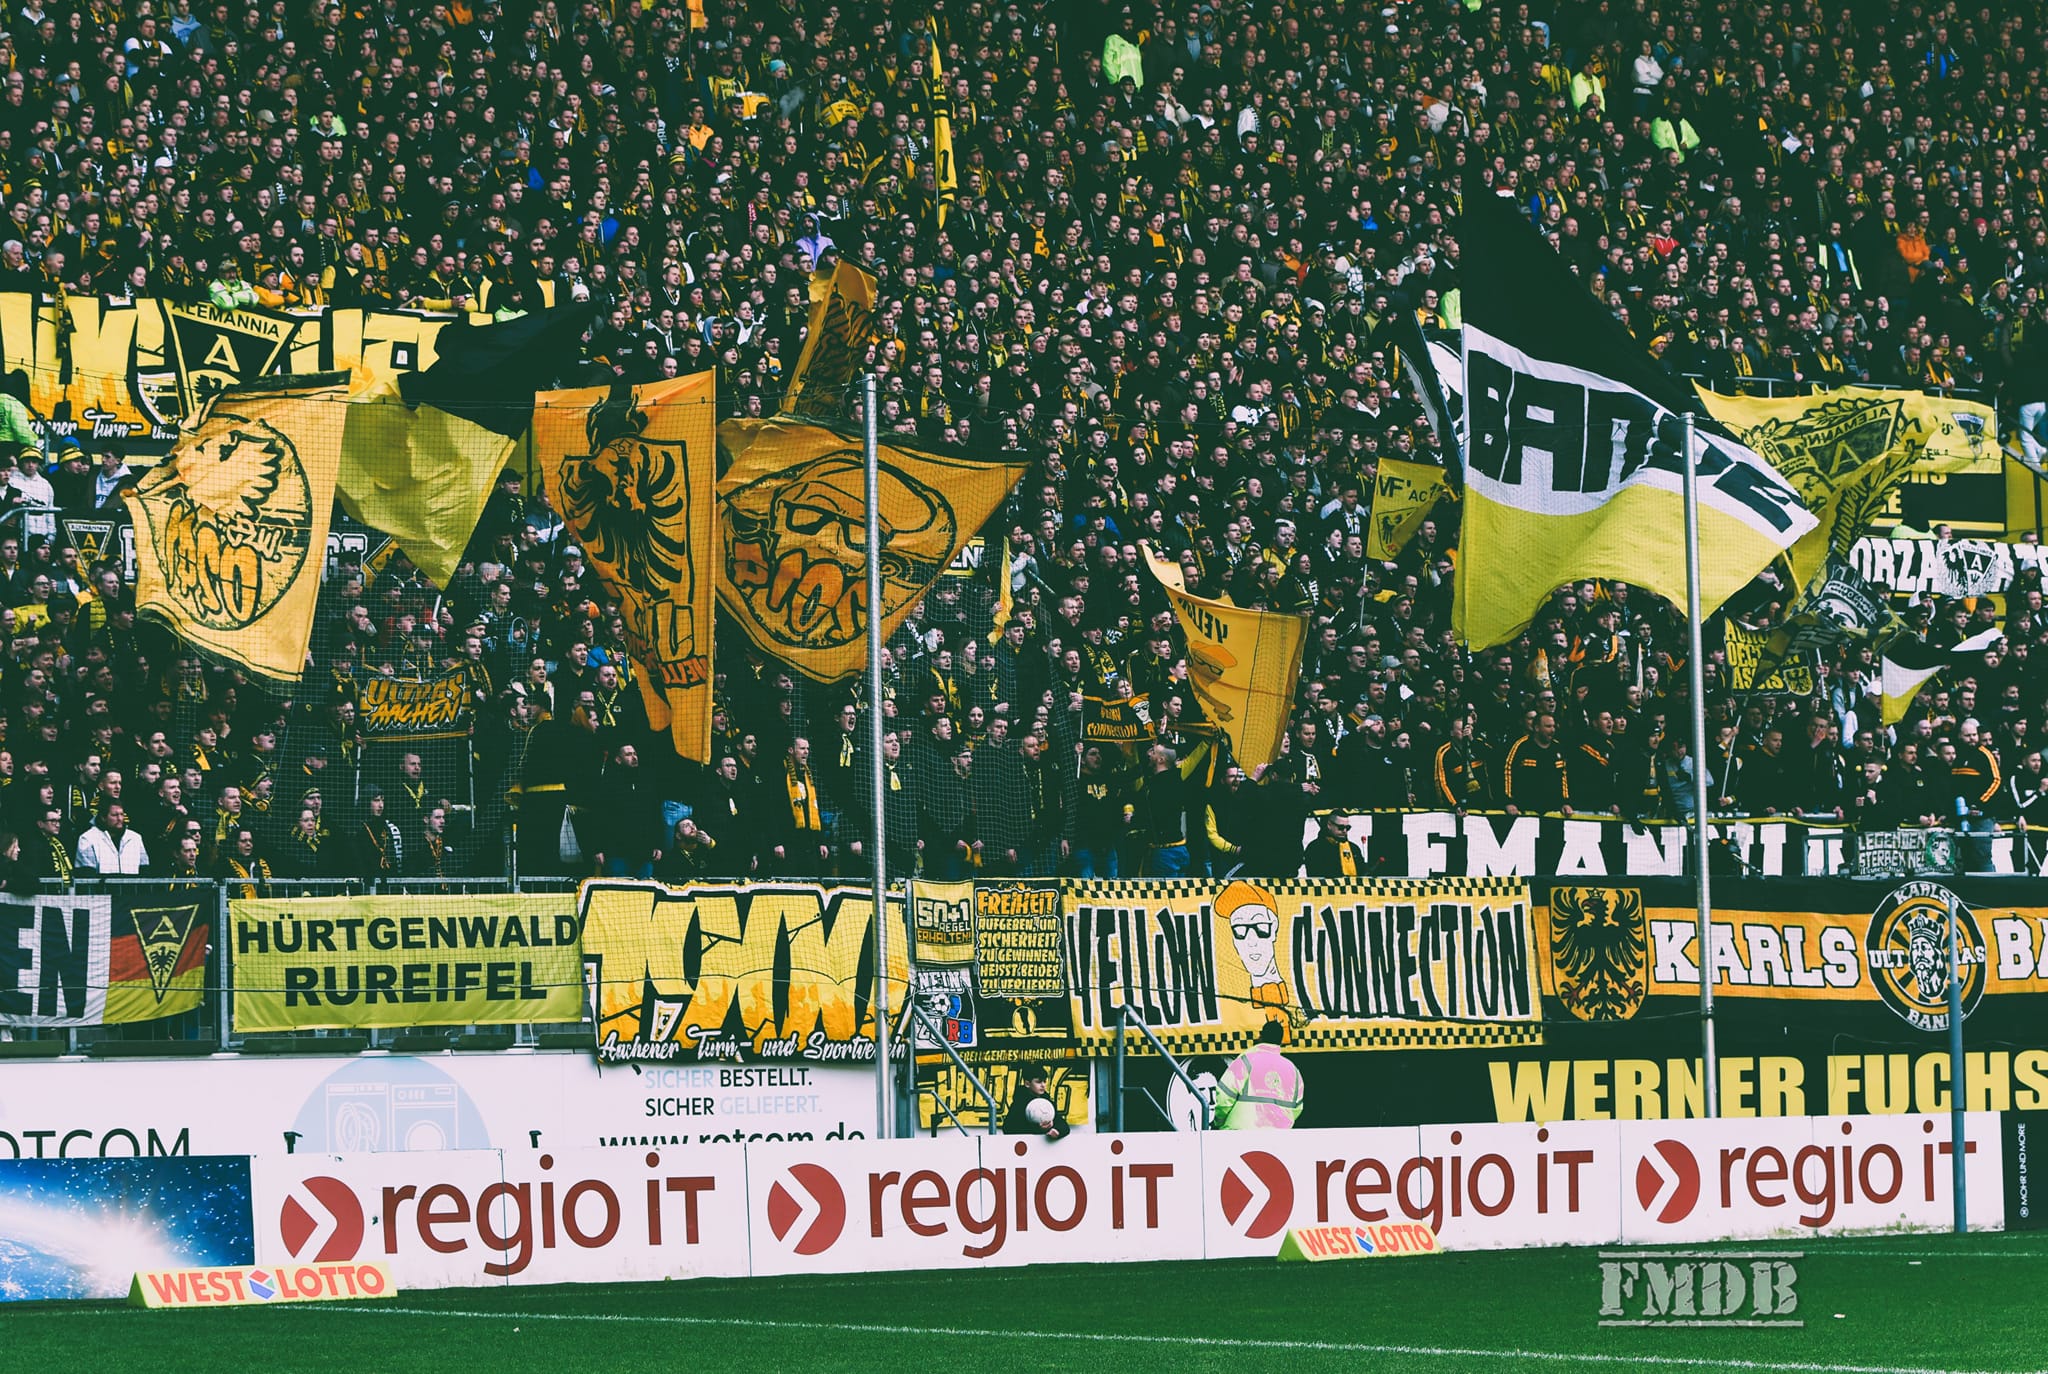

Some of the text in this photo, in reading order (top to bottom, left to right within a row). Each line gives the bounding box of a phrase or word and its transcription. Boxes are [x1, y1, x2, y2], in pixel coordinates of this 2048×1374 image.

[369, 699, 460, 726] AACHEN
[238, 914, 577, 954] HÜRTGENWALD
[979, 932, 1058, 947] SICHERHEIT
[1039, 917, 1057, 930] UM
[980, 949, 995, 962] ZU
[980, 963, 1059, 977] HEISST BEIDES
[1067, 903, 1532, 1031] YELLOW CONNECTION
[1651, 920, 1861, 989] KARLS
[285, 961, 548, 1007] RUREIFEL
[981, 979, 1061, 993] ZU VERLIEREN
[599, 1030, 680, 1060] Aachener
[762, 1033, 798, 1057] und
[947, 1019, 974, 1044] RB
[645, 1068, 812, 1089] SICHER BESTELLT.
[1489, 1049, 2048, 1121] WERNER FUCHS
[645, 1096, 823, 1116] SICHER GELIEFERT.
[1719, 1121, 1904, 1227] regio
[2018, 1122, 2028, 1206] MOHR UND MORE
[868, 1141, 1089, 1258] regio
[1316, 1131, 1516, 1237] regio
[383, 1154, 620, 1277] regio
[1298, 1223, 1434, 1257] WEST LOTTO
[148, 1264, 386, 1303] WEST LOTTO
